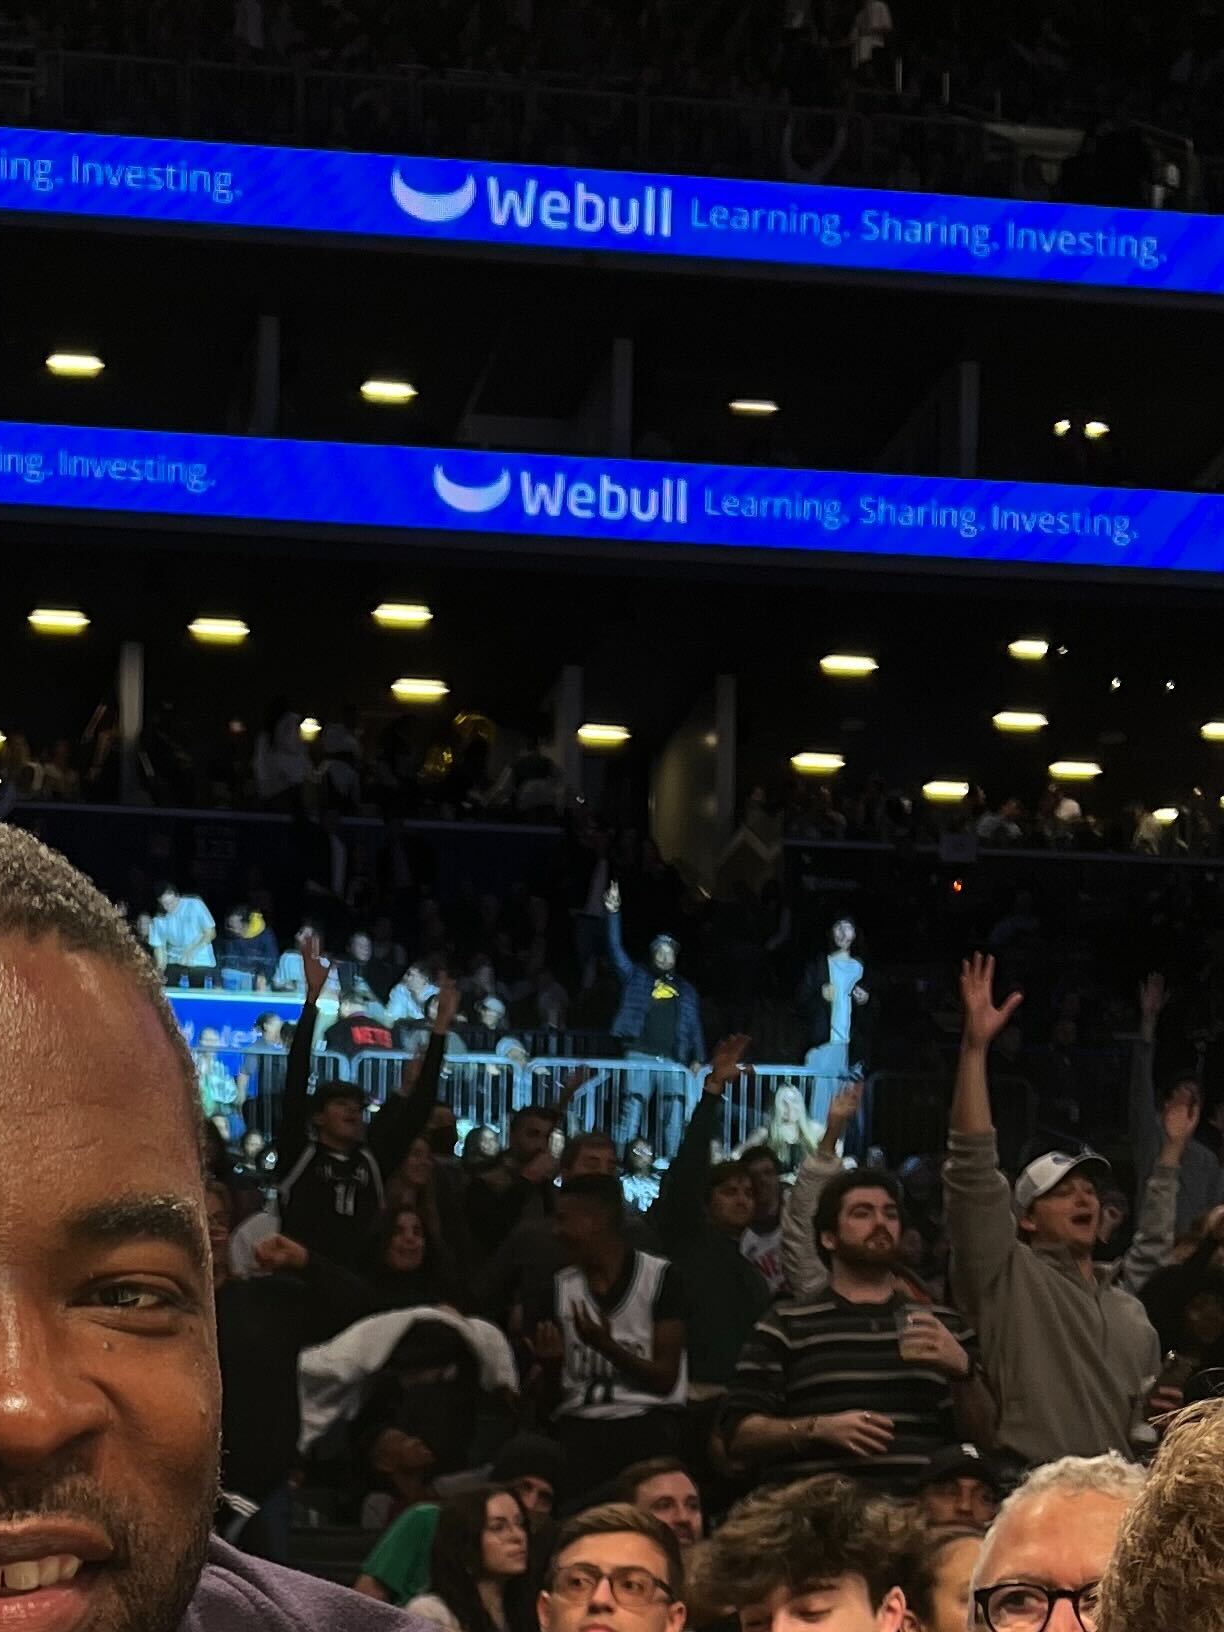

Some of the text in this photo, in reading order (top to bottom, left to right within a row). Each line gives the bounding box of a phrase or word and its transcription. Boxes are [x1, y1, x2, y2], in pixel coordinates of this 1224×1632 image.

[70, 152, 244, 204] Investing.
[486, 177, 1168, 268] Webull Learning. Sharing. Investing.
[60, 451, 216, 493] Investing.
[519, 470, 1139, 546] Webull Learning. Sharing. Investing.
